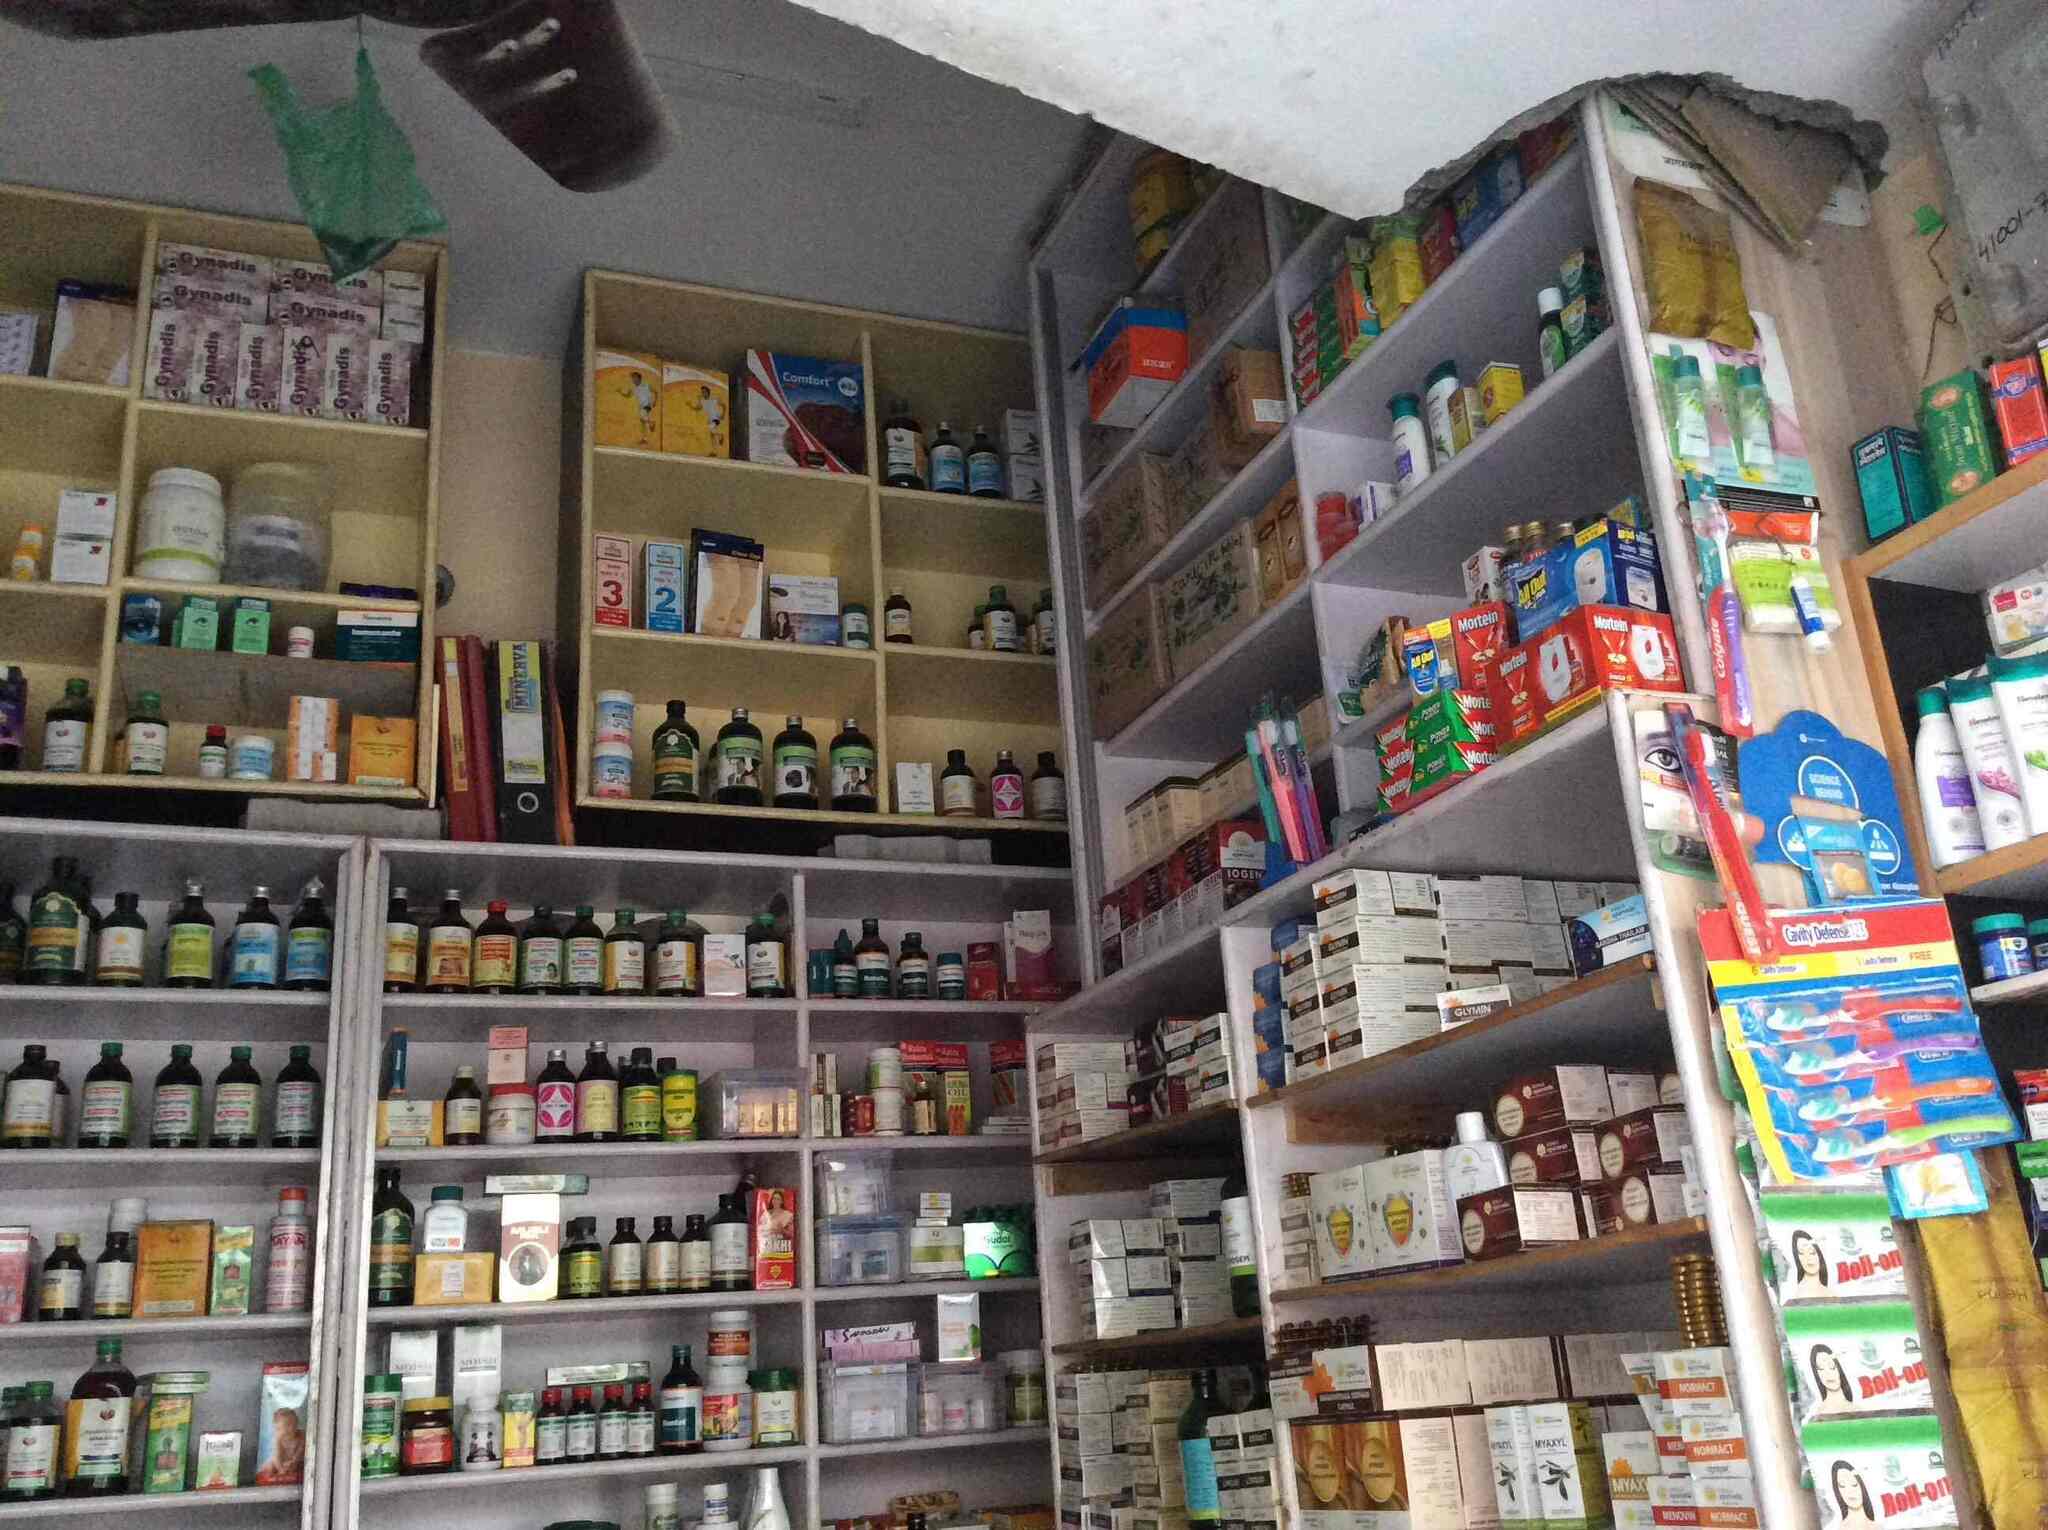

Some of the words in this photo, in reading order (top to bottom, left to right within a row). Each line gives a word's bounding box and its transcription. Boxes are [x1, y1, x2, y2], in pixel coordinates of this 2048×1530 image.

[179, 252, 256, 273] Gynadis
[174, 284, 253, 306] Gynadis
[290, 302, 367, 323] Gynadis
[155, 323, 177, 386] Gynadis
[201, 331, 220, 394] Gynadis
[245, 336, 264, 400] Gynadis
[334, 346, 350, 409] Gynadis
[783, 371, 829, 388] Comfort
[376, 352, 392, 415] Gynadis
[602, 580, 623, 607] 3
[655, 587, 676, 613] 2
[1458, 611, 1498, 632] Mortein
[1710, 617, 1726, 679] Colgate
[512, 642, 530, 707] MINERVA
[1785, 926, 1813, 945] Cavity
[1909, 950, 1933, 960] FREE
[1535, 1438, 1568, 1449] MYAXYL
